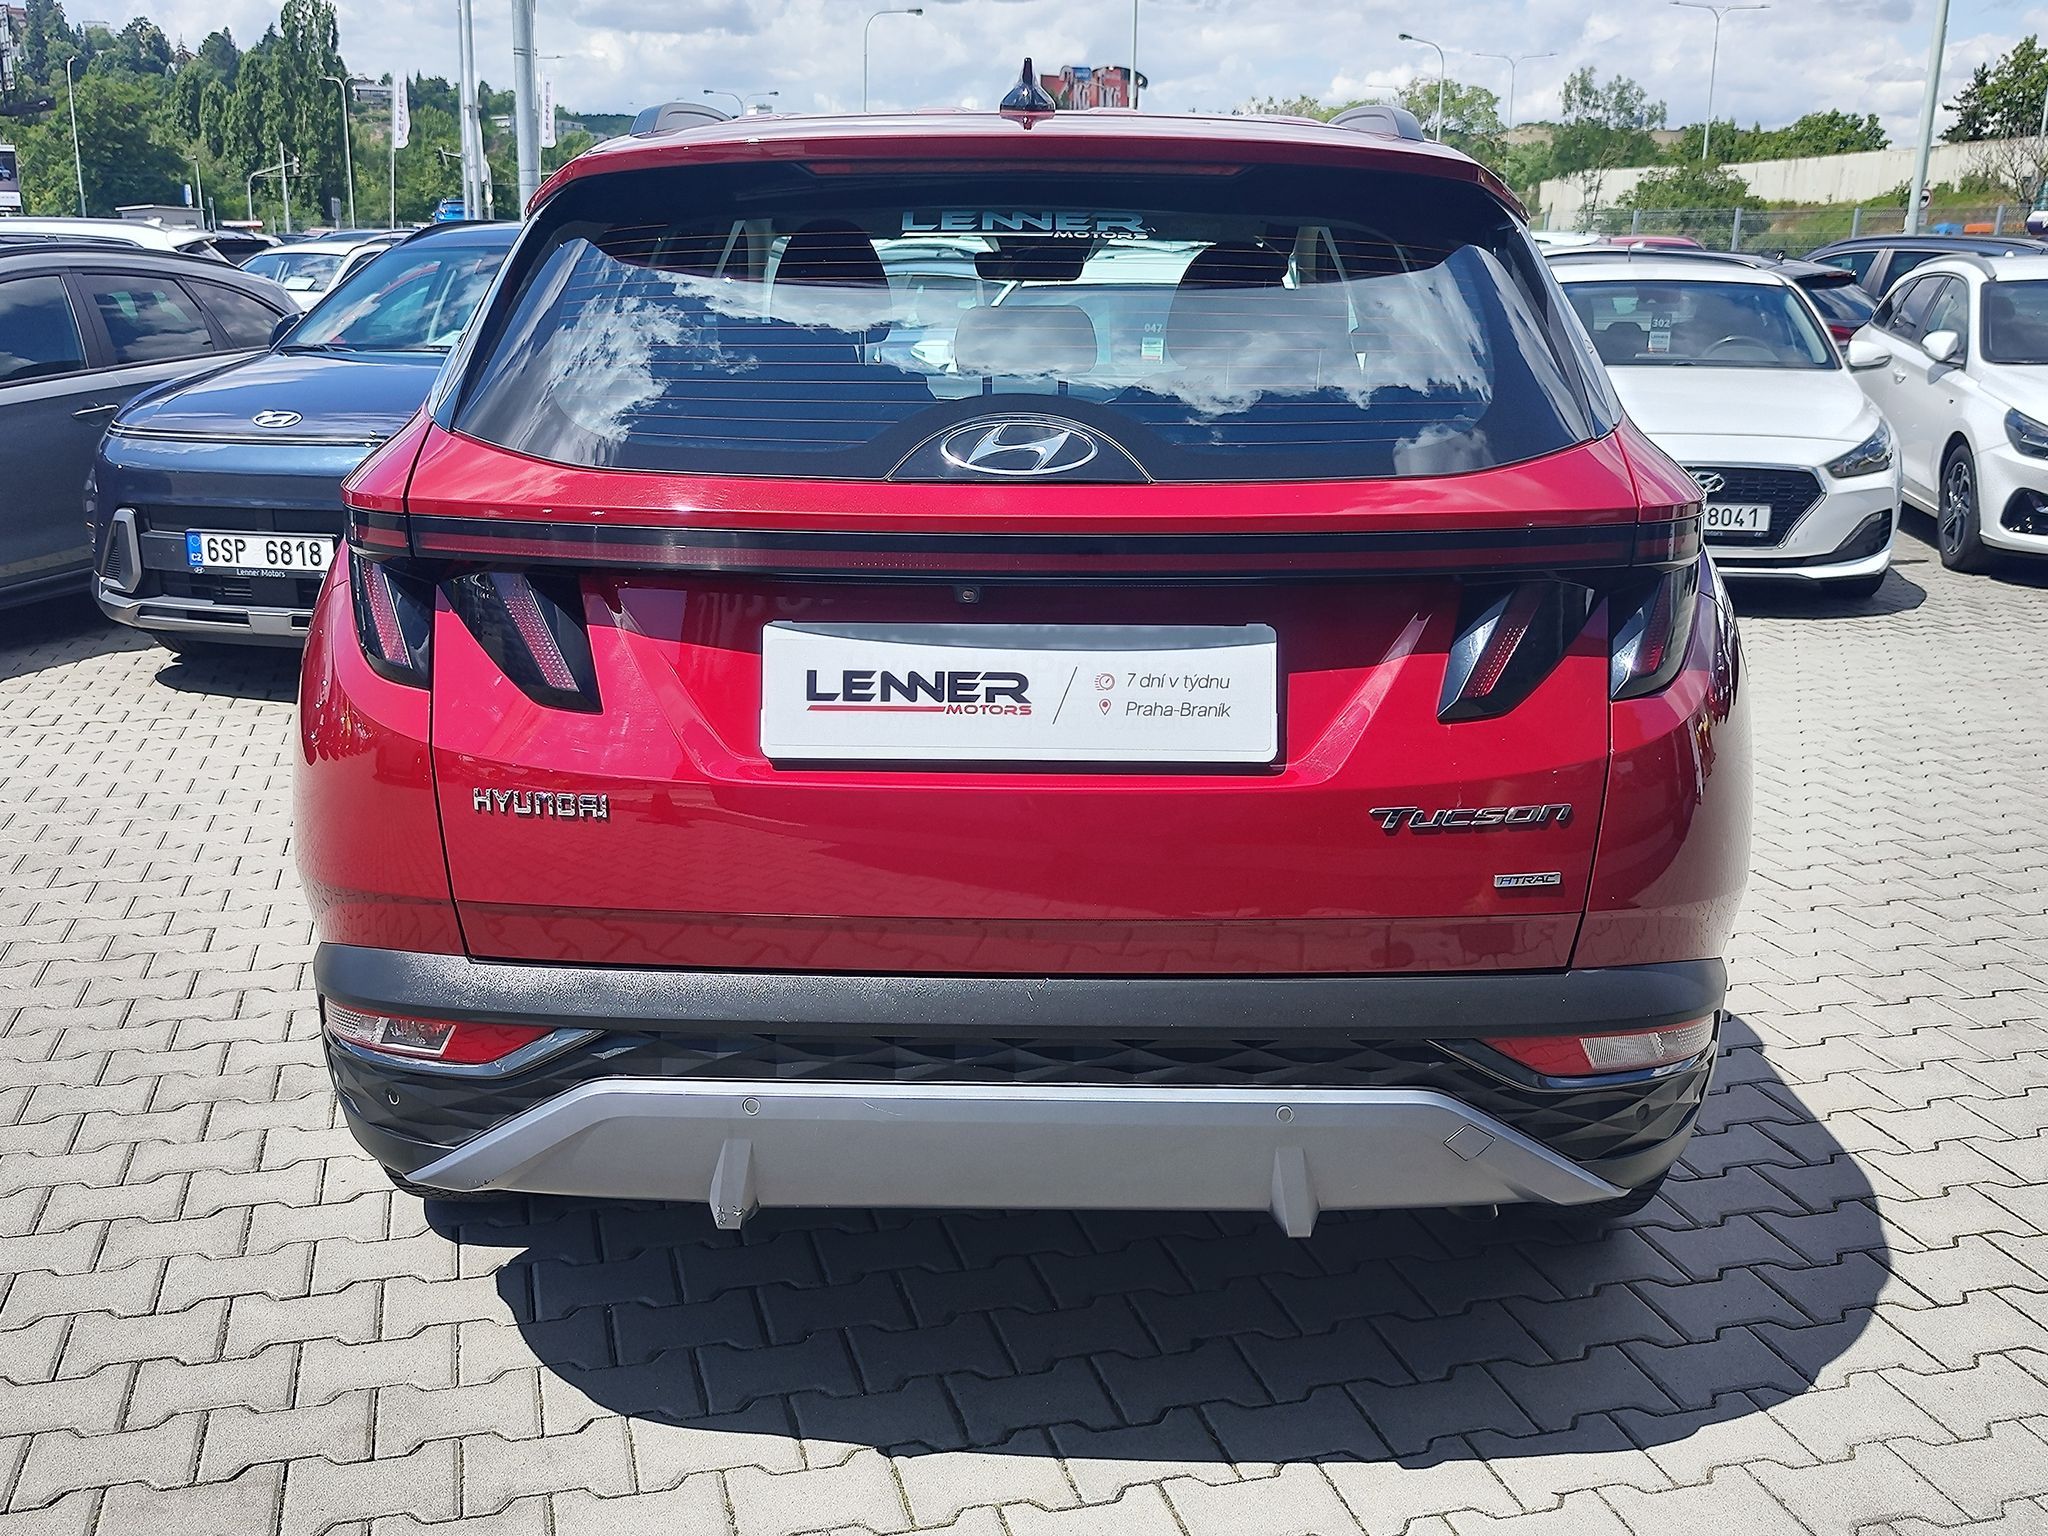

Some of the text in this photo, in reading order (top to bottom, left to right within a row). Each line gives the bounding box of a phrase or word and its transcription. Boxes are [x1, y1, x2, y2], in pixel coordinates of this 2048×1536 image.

[902, 211, 1149, 232] LENNER
[1051, 231, 1149, 240] MOTORS
[1144, 323, 1163, 333] 047
[1651, 318, 1671, 328] 302
[1708, 507, 1758, 527] 8041
[191, 552, 203, 562] CZ
[207, 537, 322, 567] 6SP 6818
[236, 568, 286, 578] Lenner Motors
[806, 669, 1032, 704] LENNER
[1127, 672, 1231, 692] 7 dní v týdnu
[946, 704, 1032, 716] MOTORS
[1125, 701, 1232, 718] Praha-Braník
[473, 787, 608, 818] HYUNDAI
[1499, 874, 1558, 885] HTRAC
